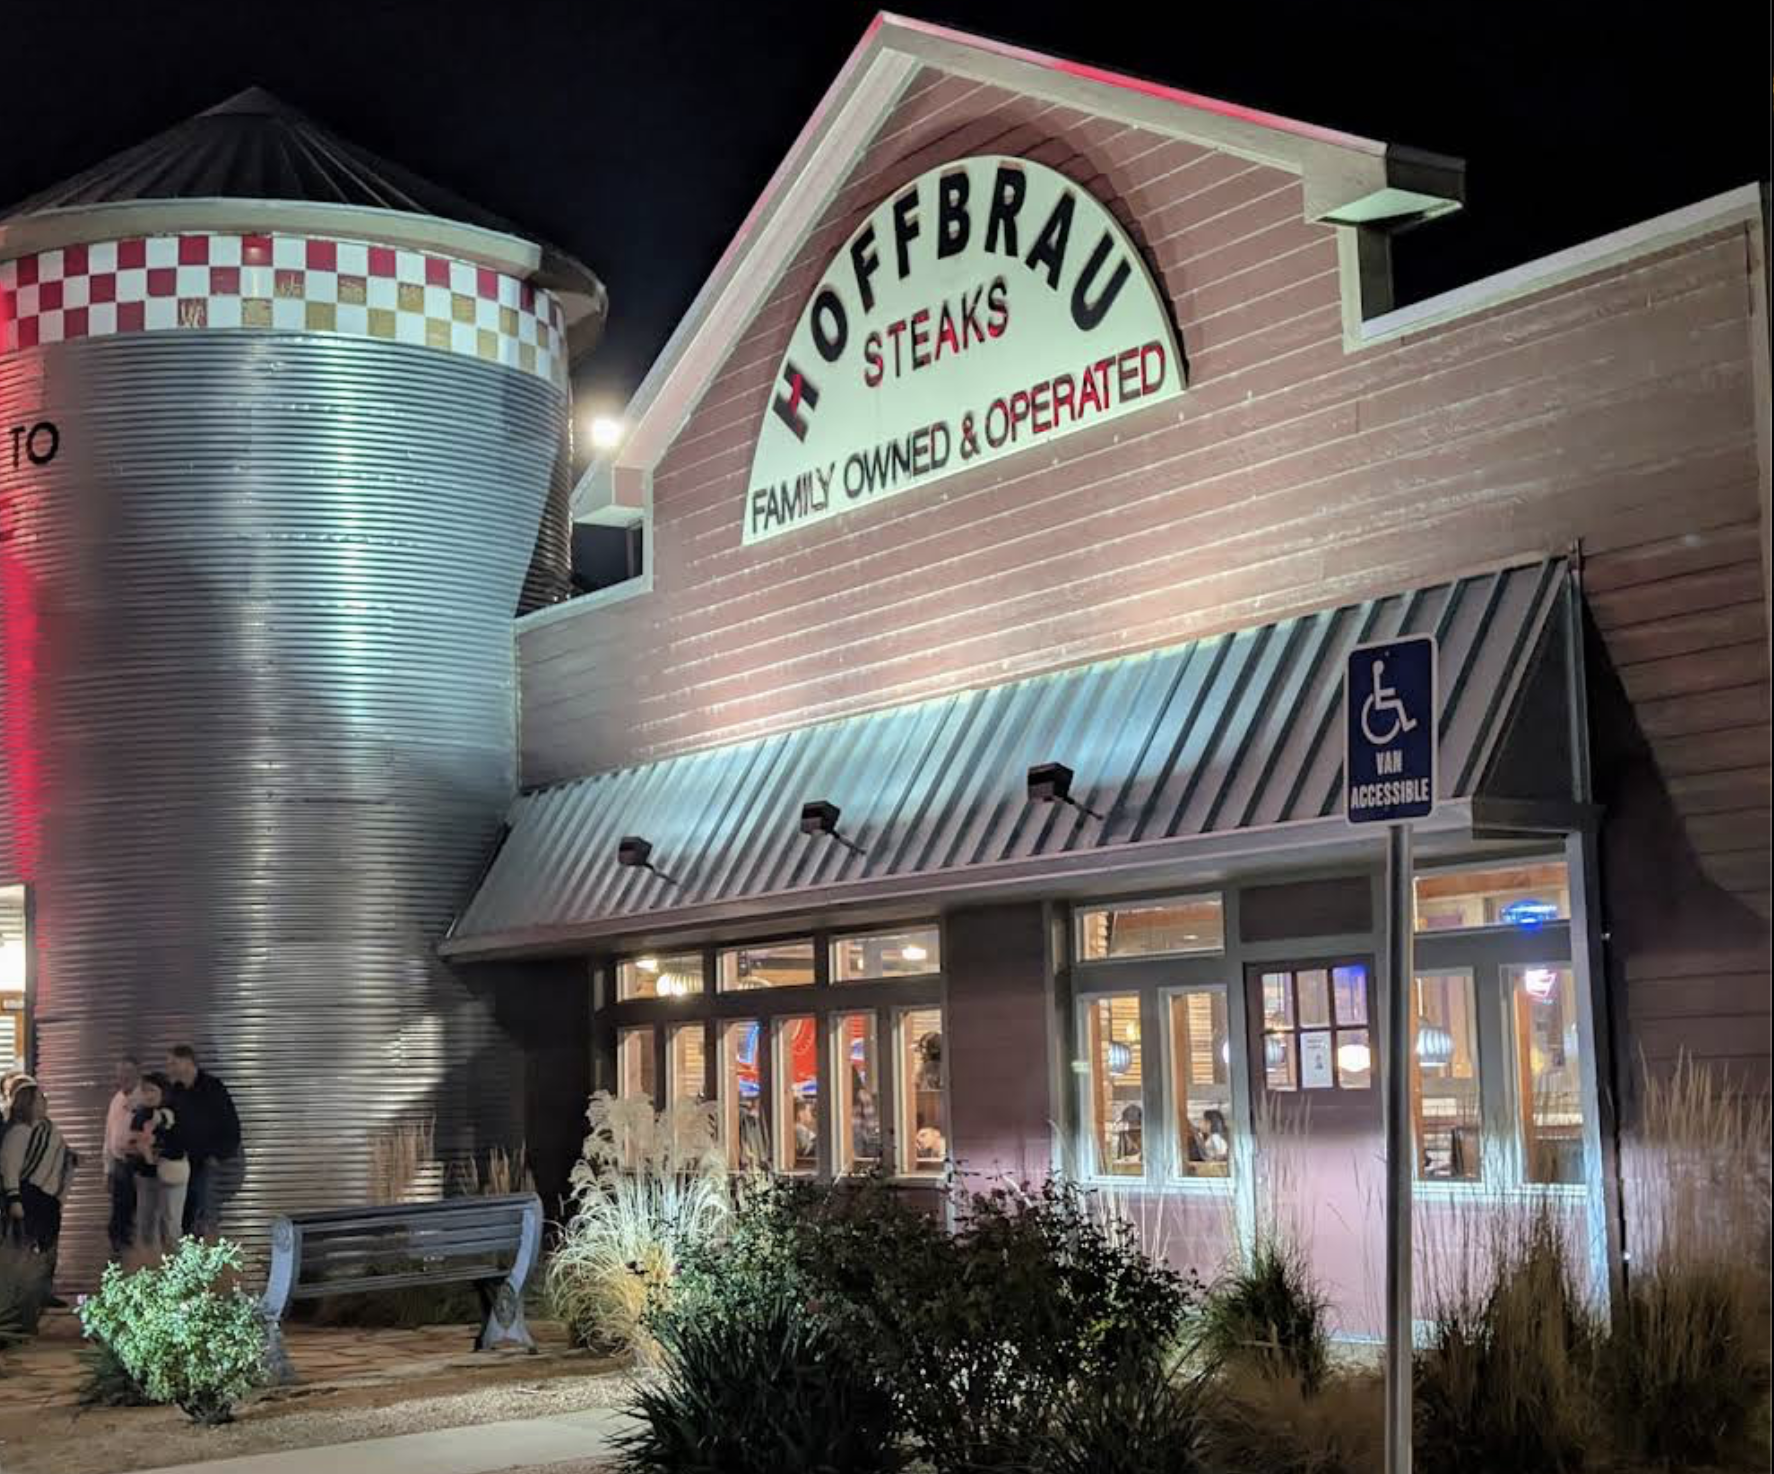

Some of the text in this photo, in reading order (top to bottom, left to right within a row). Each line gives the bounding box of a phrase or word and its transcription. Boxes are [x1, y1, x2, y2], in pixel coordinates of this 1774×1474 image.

[772, 165, 1132, 443] HOFFBRAU
[863, 275, 1009, 388] STEAKS
[9, 422, 59, 468] TO
[752, 340, 1166, 534] FAMILY OWNED & OPERATED
[1350, 778, 1430, 809] ACCESSIBLE
[1376, 750, 1403, 775] VAN
